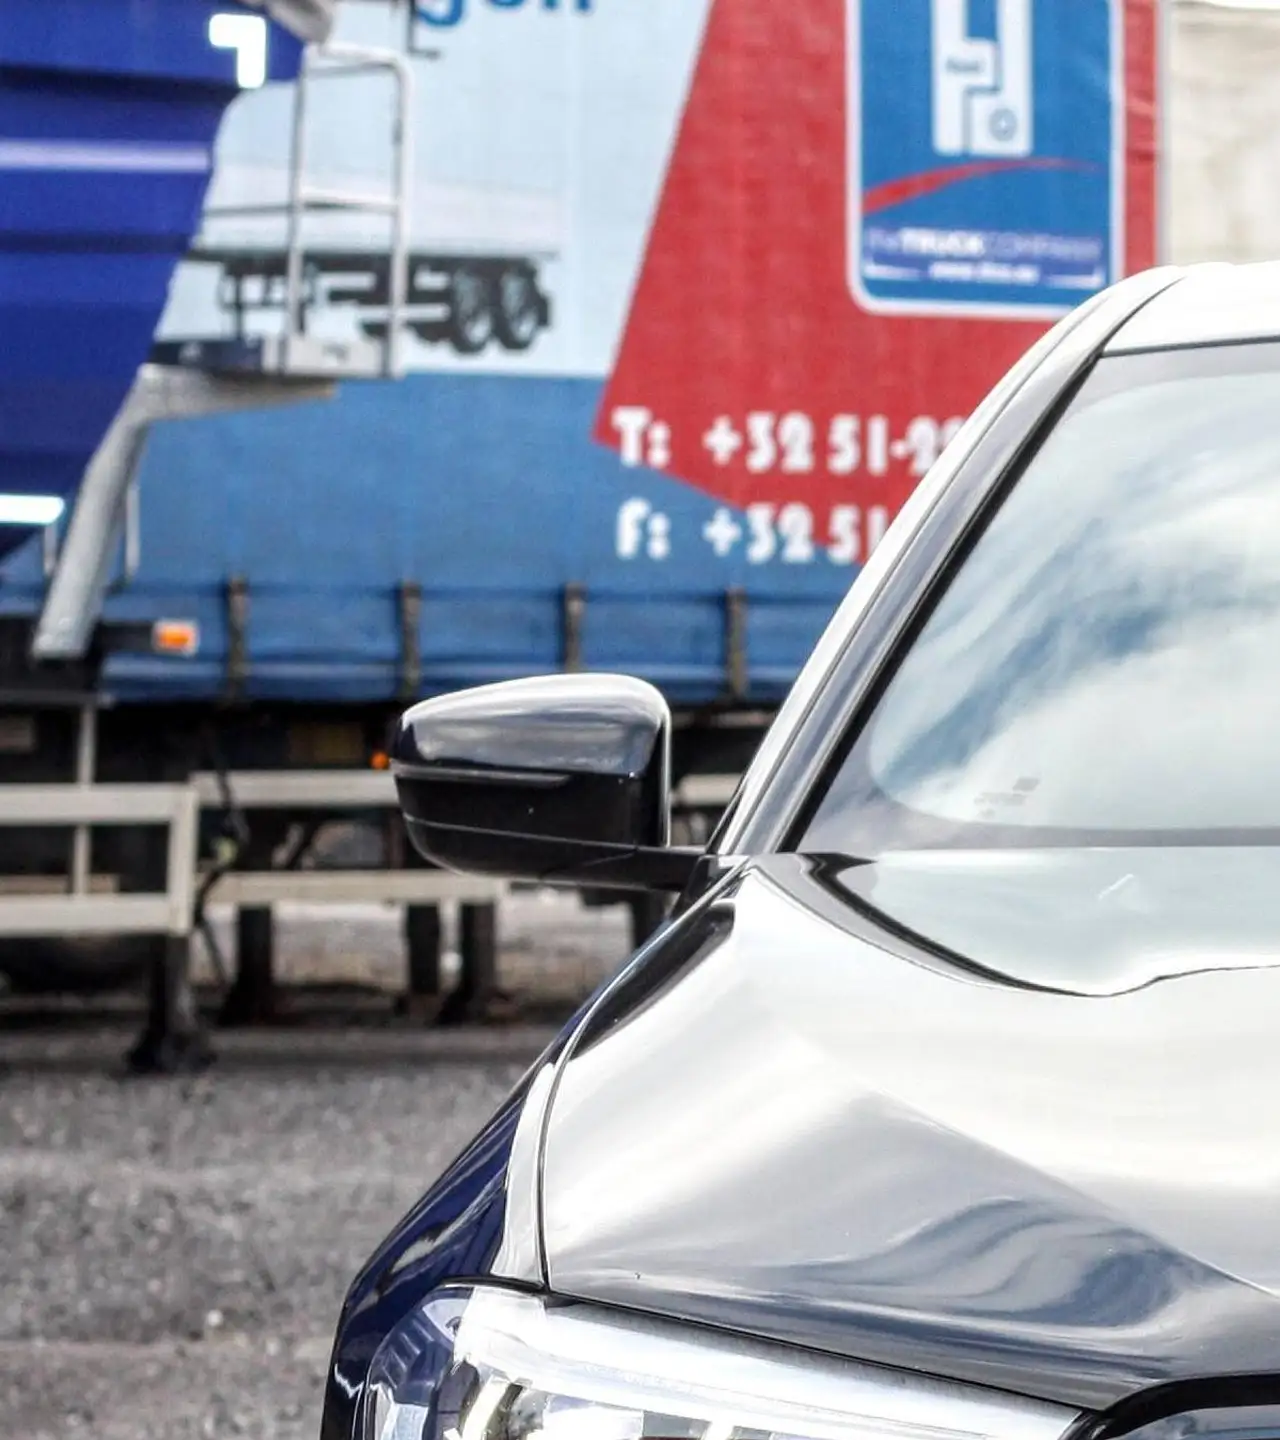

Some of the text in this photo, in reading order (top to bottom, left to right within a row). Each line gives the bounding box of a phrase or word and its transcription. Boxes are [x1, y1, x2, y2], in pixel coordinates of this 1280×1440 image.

[611, 405, 671, 467] T:
[702, 410, 815, 475] +32
[702, 501, 815, 564] +32
